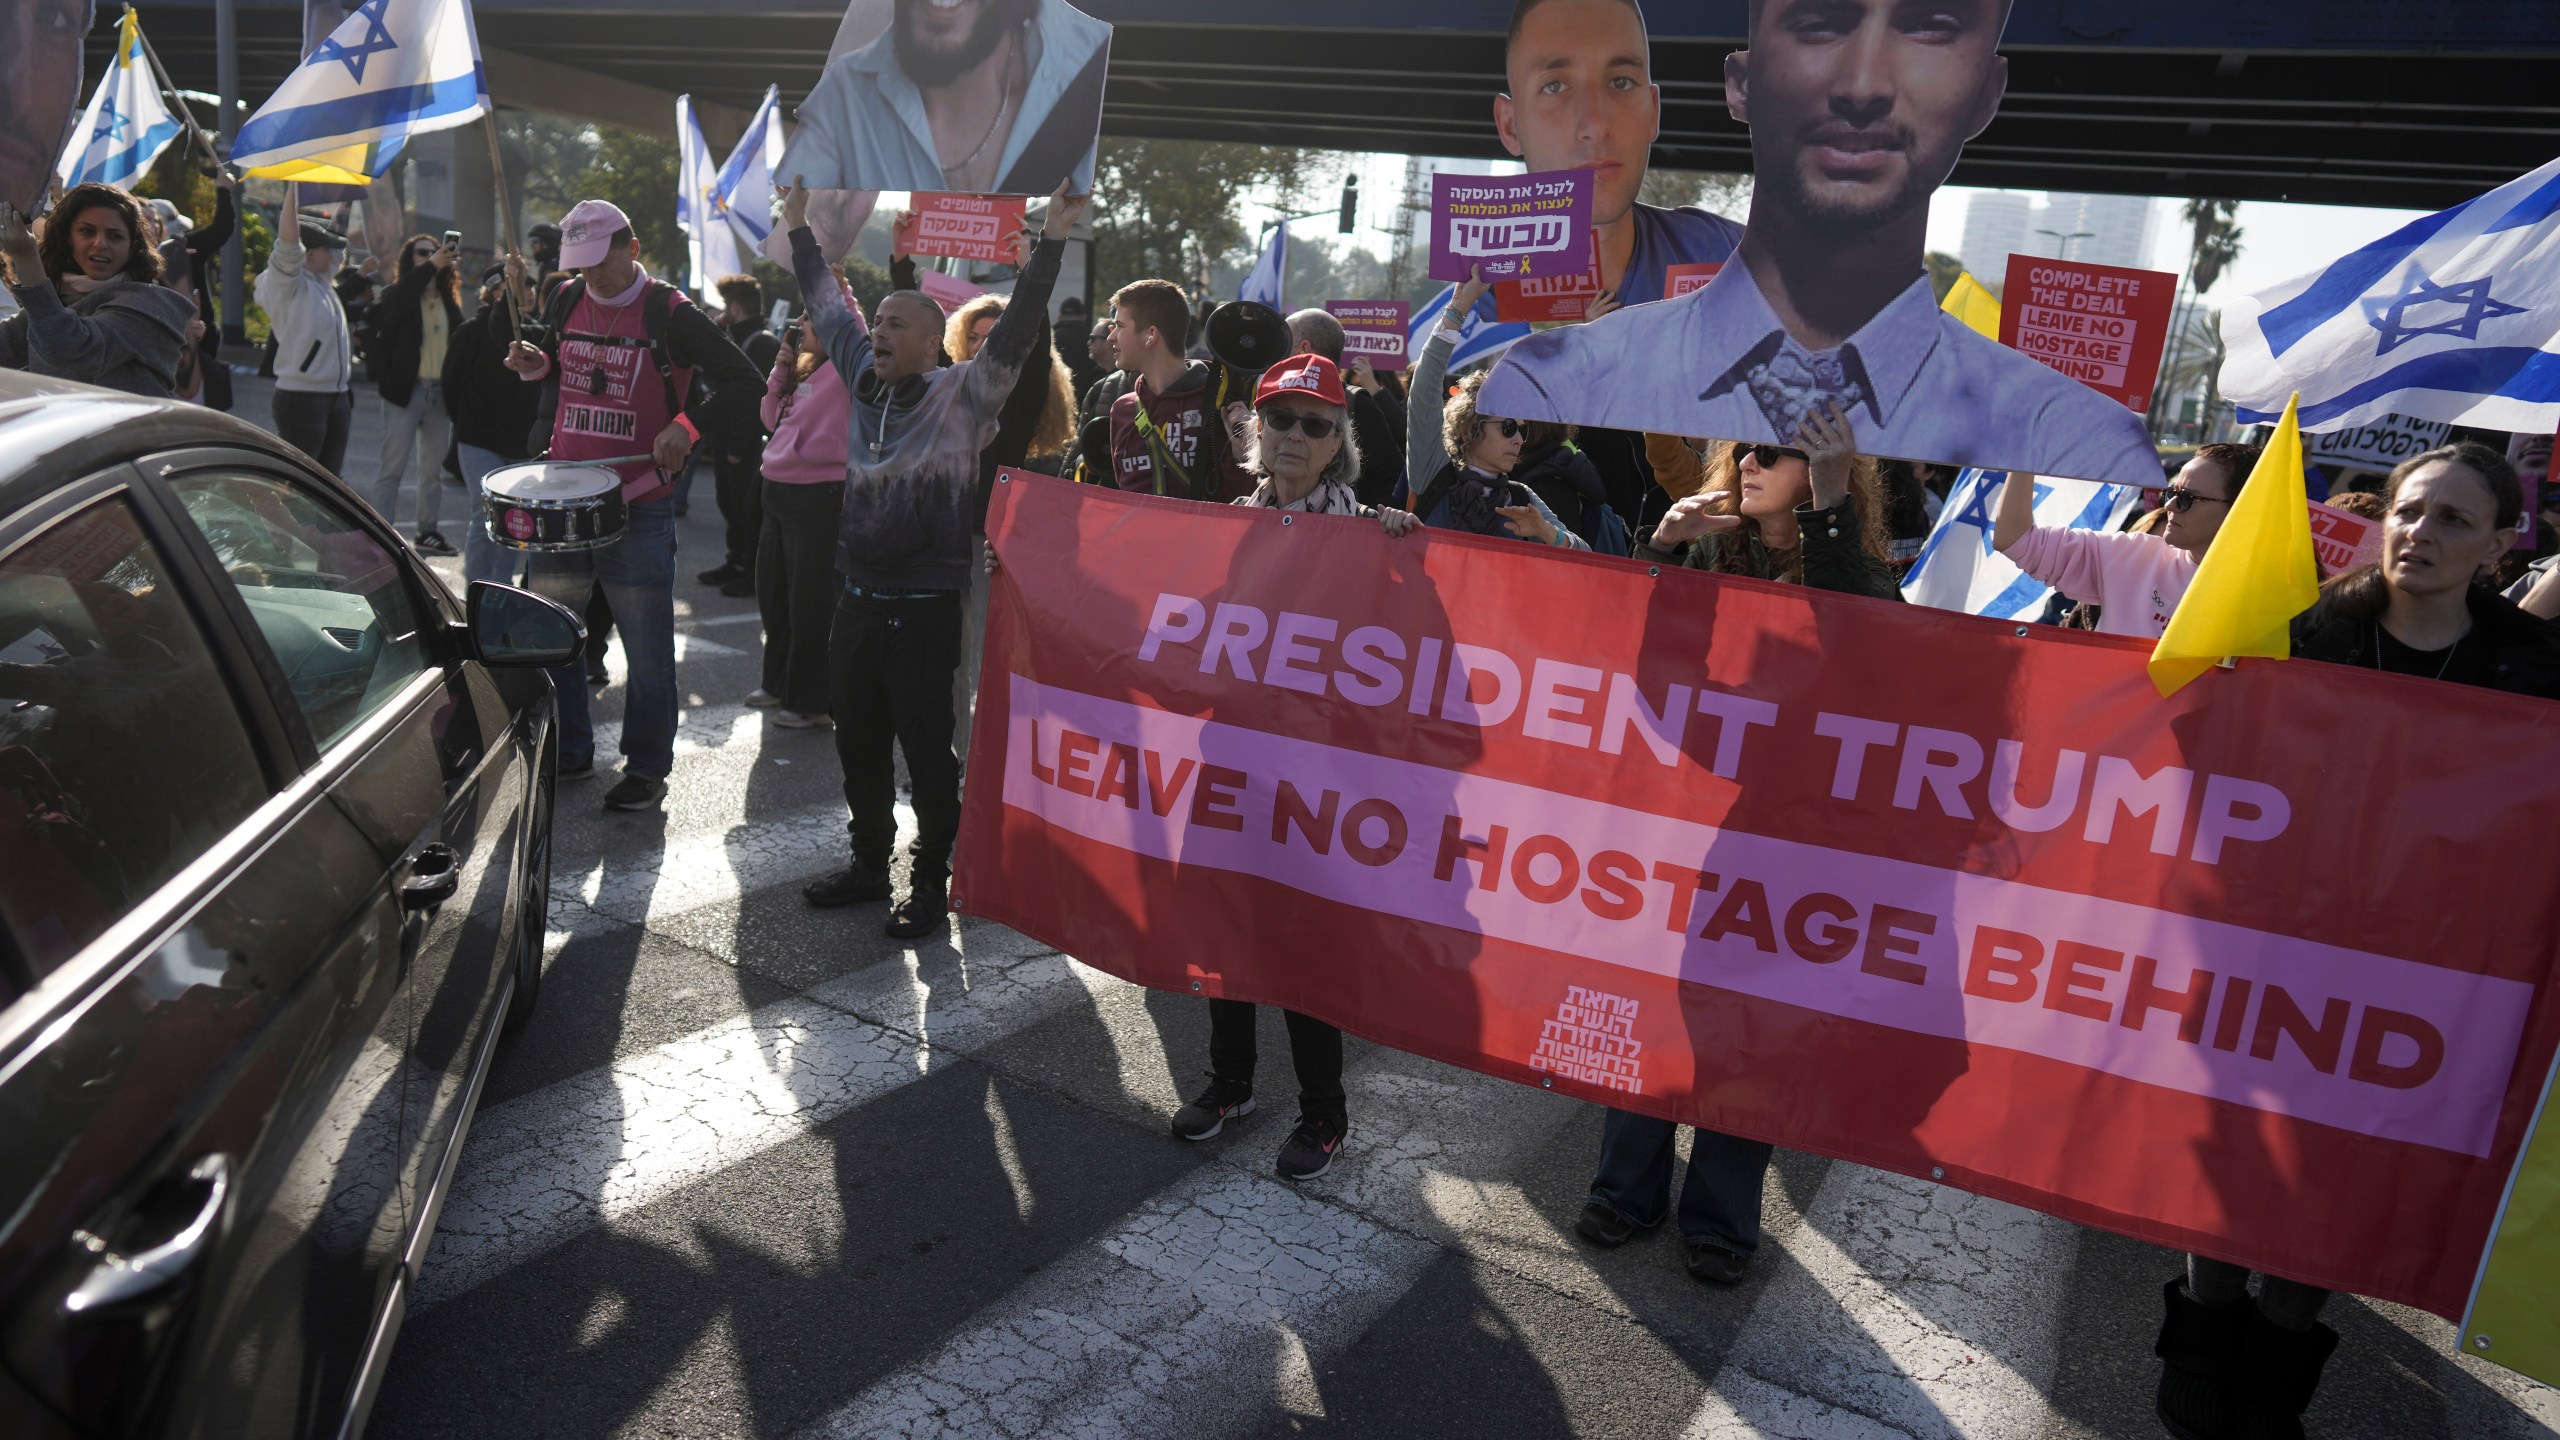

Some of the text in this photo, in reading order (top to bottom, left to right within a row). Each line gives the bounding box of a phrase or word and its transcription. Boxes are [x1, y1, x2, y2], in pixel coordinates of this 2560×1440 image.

[1450, 180, 1575, 202] לקבל את העסקה
[1450, 196, 1574, 215] לעצור את המלחמה
[924, 216, 996, 236] רק עסקה
[1457, 221, 1563, 250] עכשיו
[916, 238, 996, 259] תציל חיים
[2030, 267, 2140, 297] COMPLETE
[1333, 307, 1398, 318] לקבל את העסקה
[2030, 286, 2126, 316] THE DEAL
[2026, 308, 2125, 338] LEAVE NO
[1364, 336, 1400, 351] לצאת
[2022, 331, 2122, 362] HOSTAGE
[1279, 377, 1319, 391] WAR
[593, 407, 635, 437] אנחנו
[1138, 592, 1779, 779] PRESIDENT
[1813, 710, 2292, 865] TRUMP
[1029, 717, 2445, 1090] LEAVE NO HOSTAGE BEHIND
[1565, 985, 1640, 1019] מחאת
[1557, 1003, 1633, 1037] הנשים
[1541, 1019, 1642, 1059] להחזרת
[1535, 1037, 1641, 1077] החטופות
[1529, 1053, 1643, 1095] והחטופים
